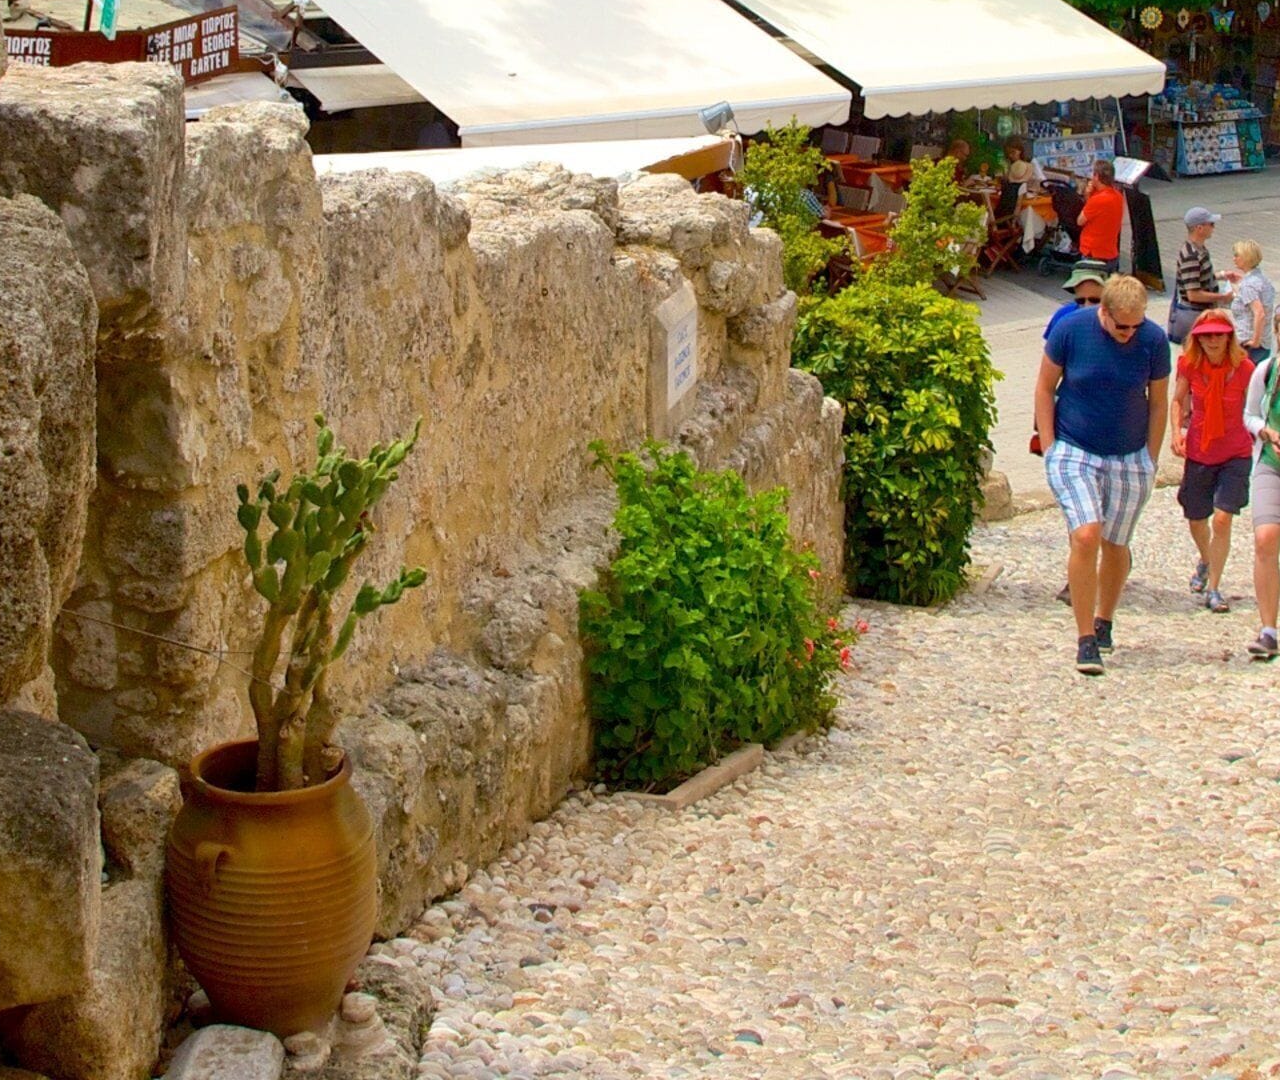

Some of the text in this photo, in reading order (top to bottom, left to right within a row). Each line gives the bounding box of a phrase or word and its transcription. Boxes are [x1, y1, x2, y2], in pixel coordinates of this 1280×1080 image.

[173, 42, 193, 63] BAR
[202, 30, 236, 54] GEORGE
[190, 51, 230, 77] GARTEN
